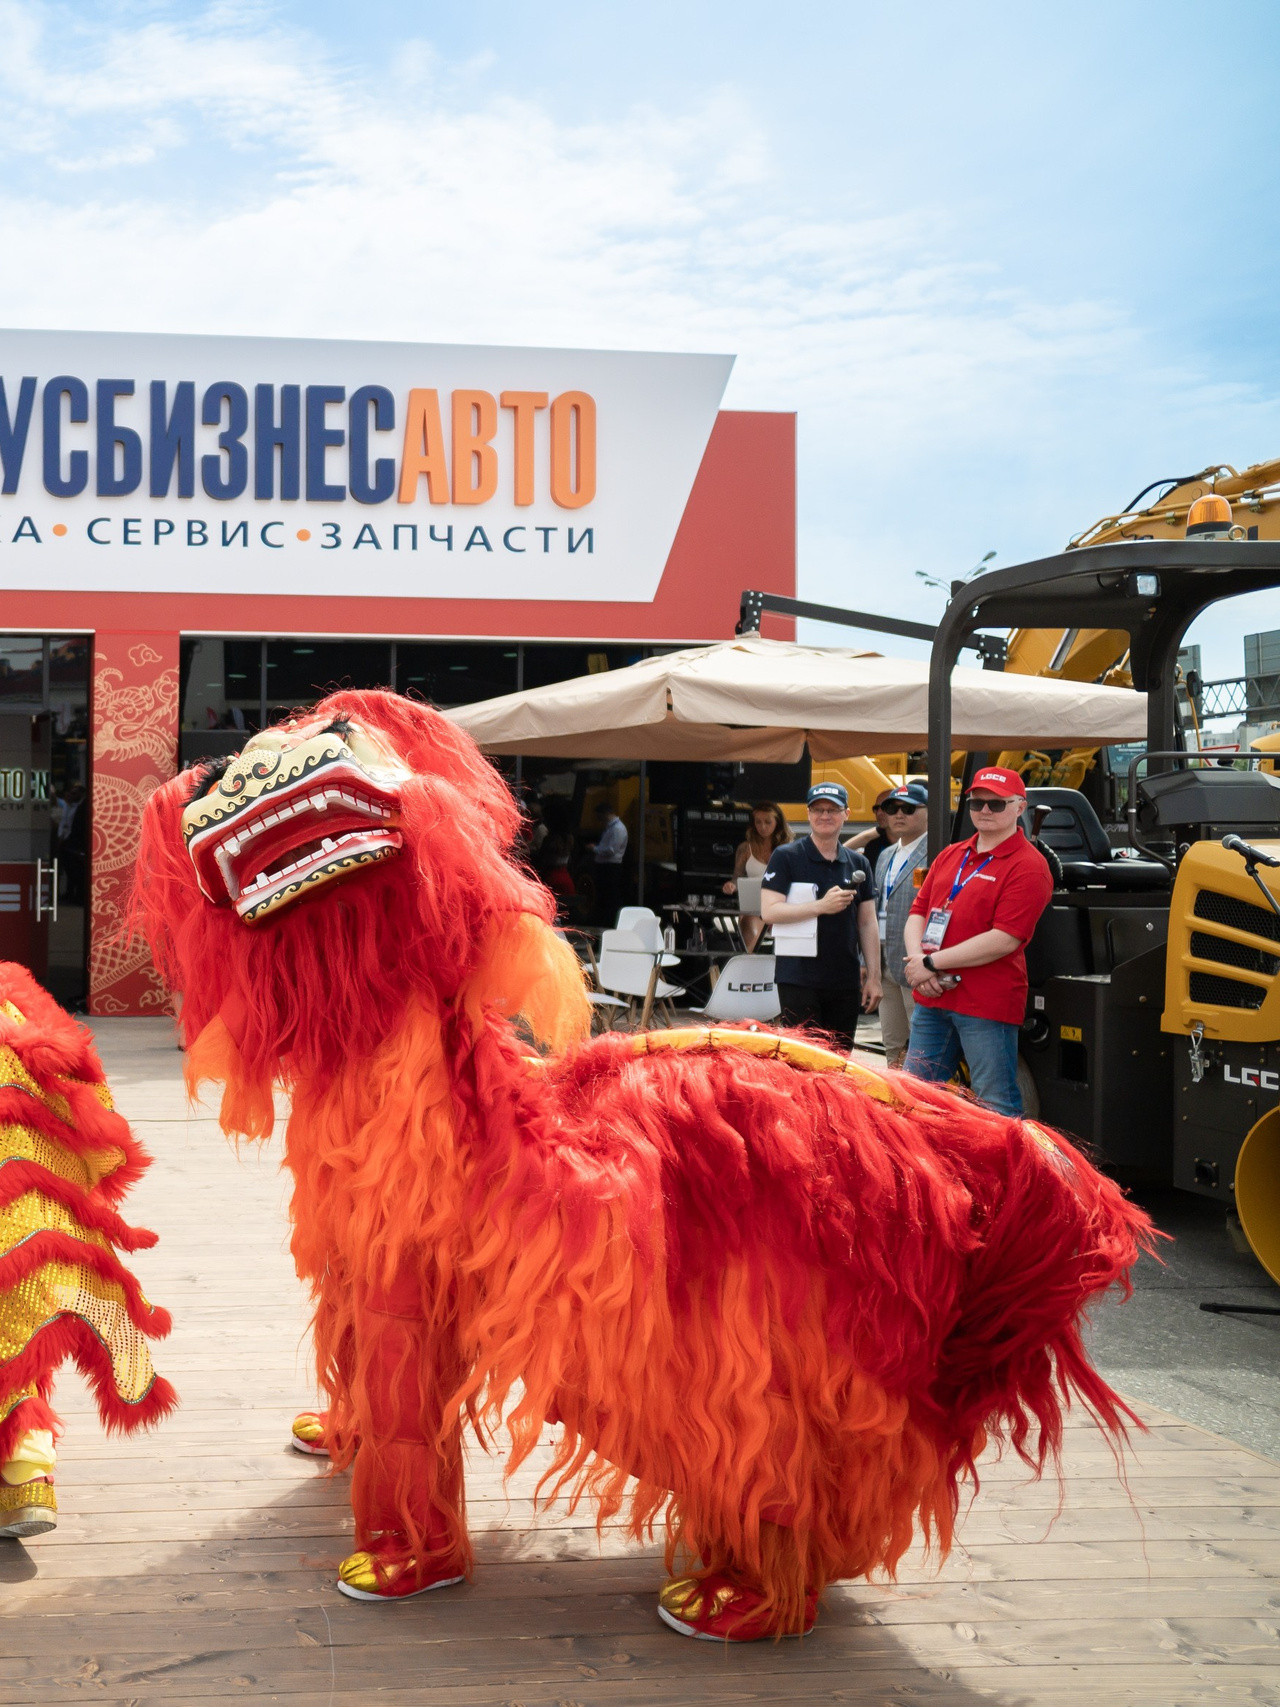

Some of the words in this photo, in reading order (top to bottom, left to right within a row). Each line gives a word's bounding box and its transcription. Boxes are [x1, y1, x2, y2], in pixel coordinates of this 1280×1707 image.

[86, 516, 286, 550] СЕРВИС
[320, 522, 595, 554] ЗАПЧАСТИ
[728, 982, 773, 992] LGCE
